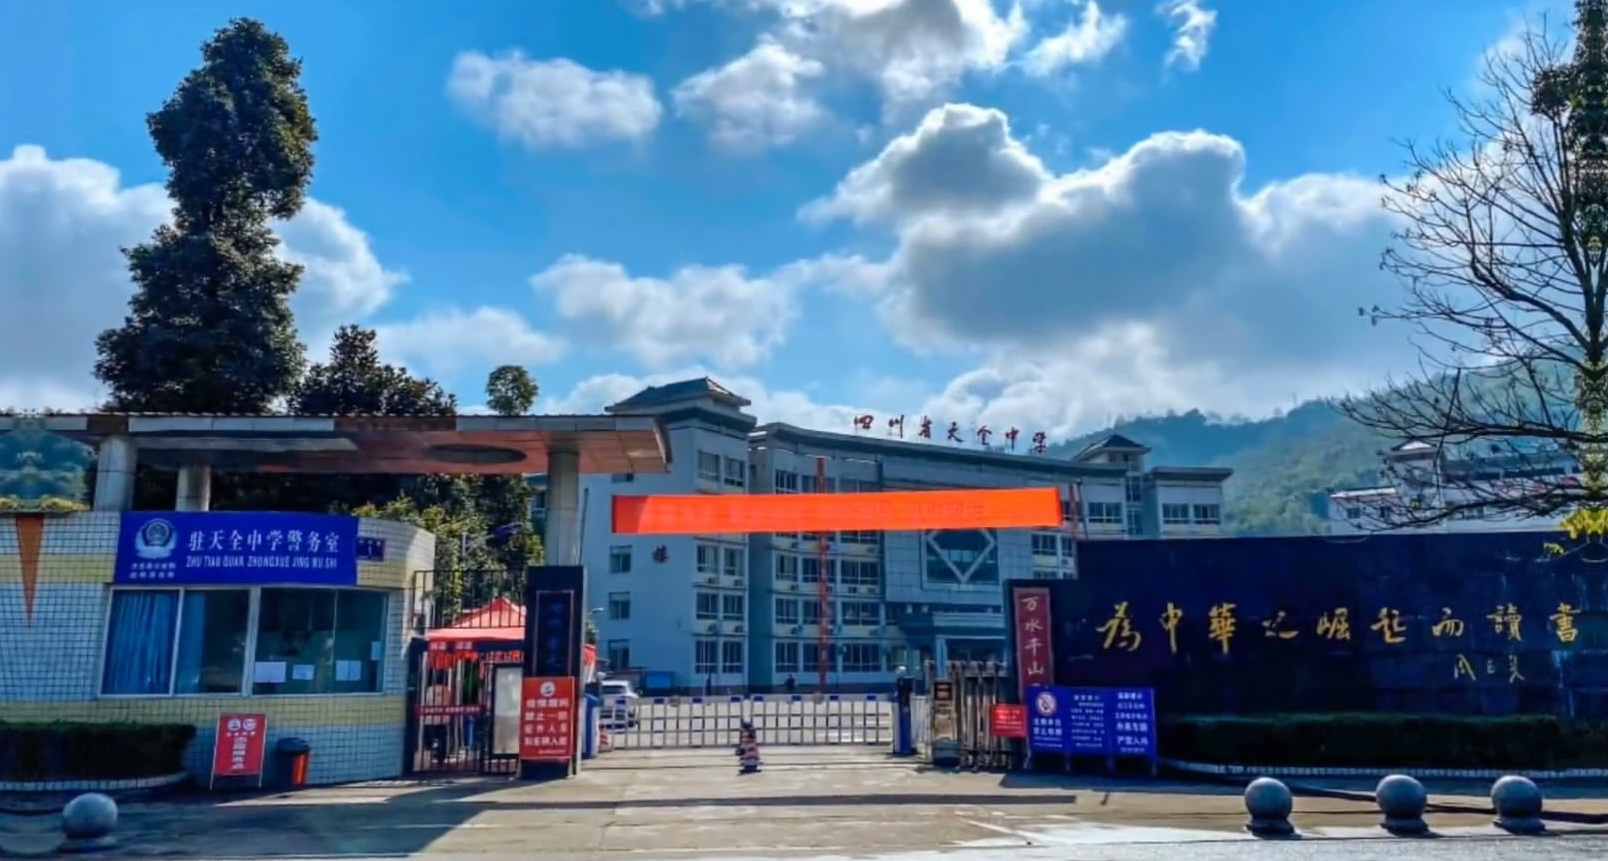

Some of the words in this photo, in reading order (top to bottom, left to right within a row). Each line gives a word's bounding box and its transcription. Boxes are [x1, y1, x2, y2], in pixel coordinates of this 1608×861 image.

[854, 414, 1047, 454] 四川省天全中学
[188, 529, 340, 553] 驻天全中学警务室
[185, 556, 202, 568] ZHU
[223, 556, 244, 568] QUAN
[246, 556, 290, 568] ZHONGXUE
[292, 557, 309, 568] JING
[1021, 595, 1045, 687] 万水千山
